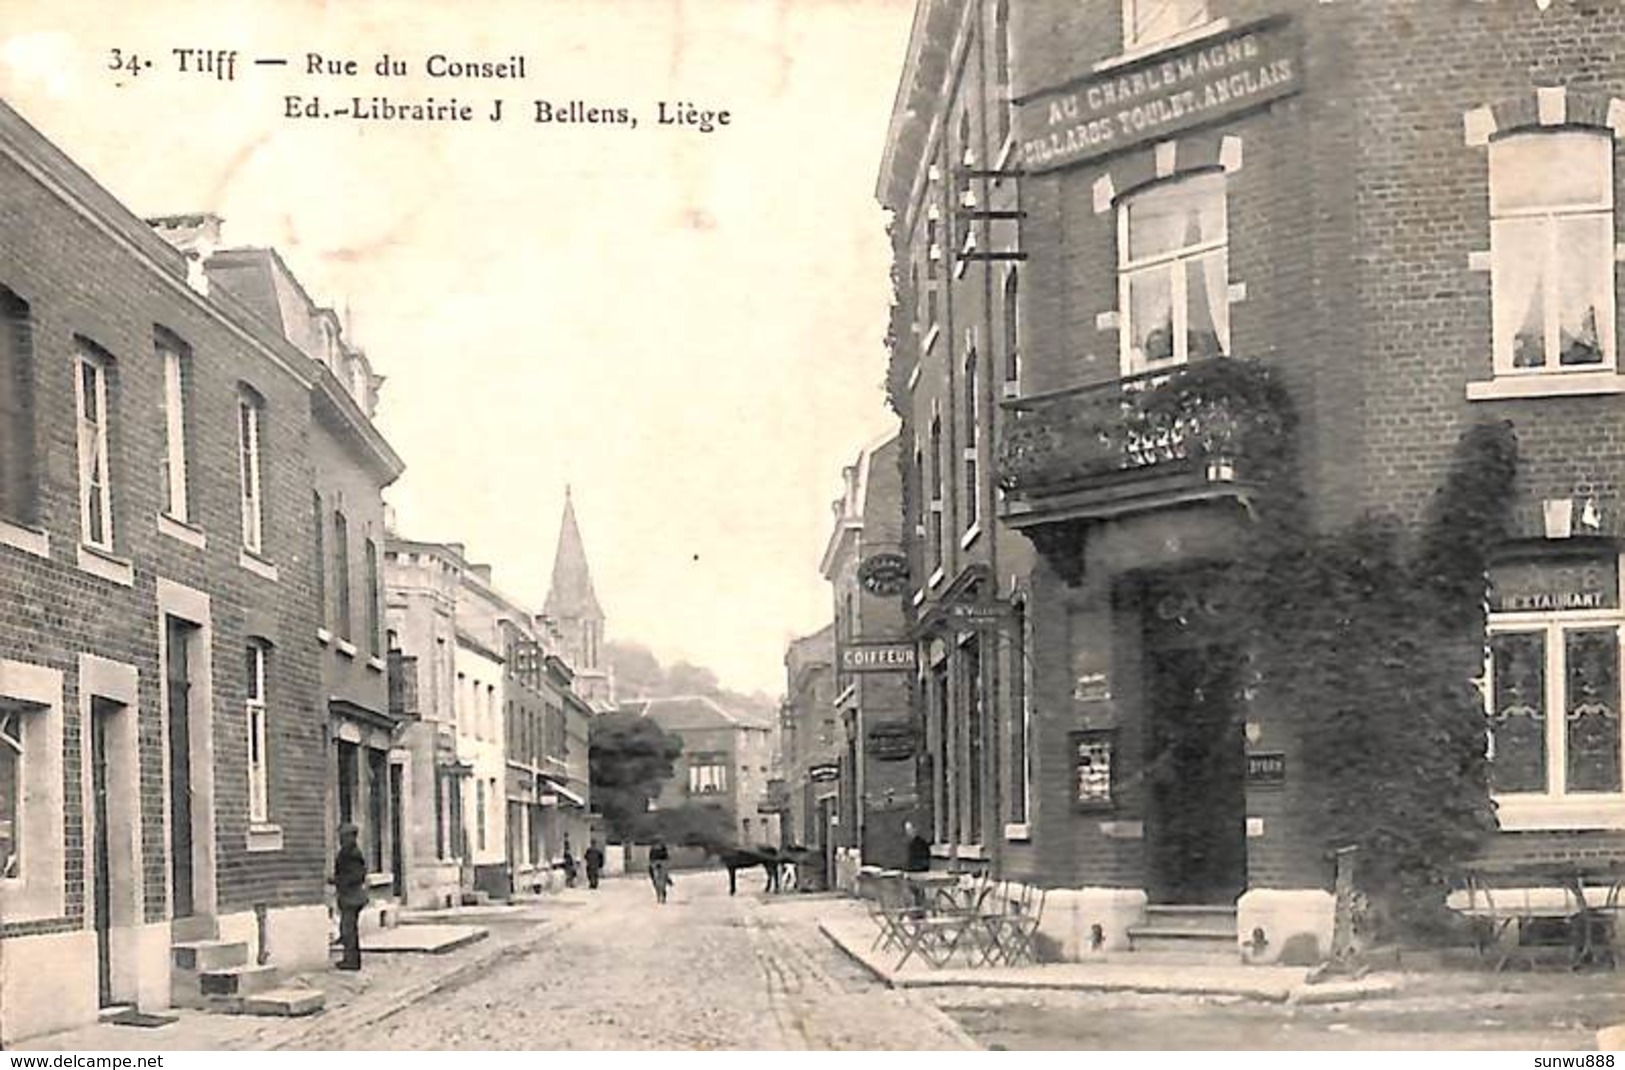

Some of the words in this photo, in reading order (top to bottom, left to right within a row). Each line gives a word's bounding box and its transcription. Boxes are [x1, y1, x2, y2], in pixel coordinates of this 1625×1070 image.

[1049, 100, 1077, 125] AU
[1087, 35, 1258, 109] CHARLEMAGNE
[843, 650, 915, 665] COIFFEUR
